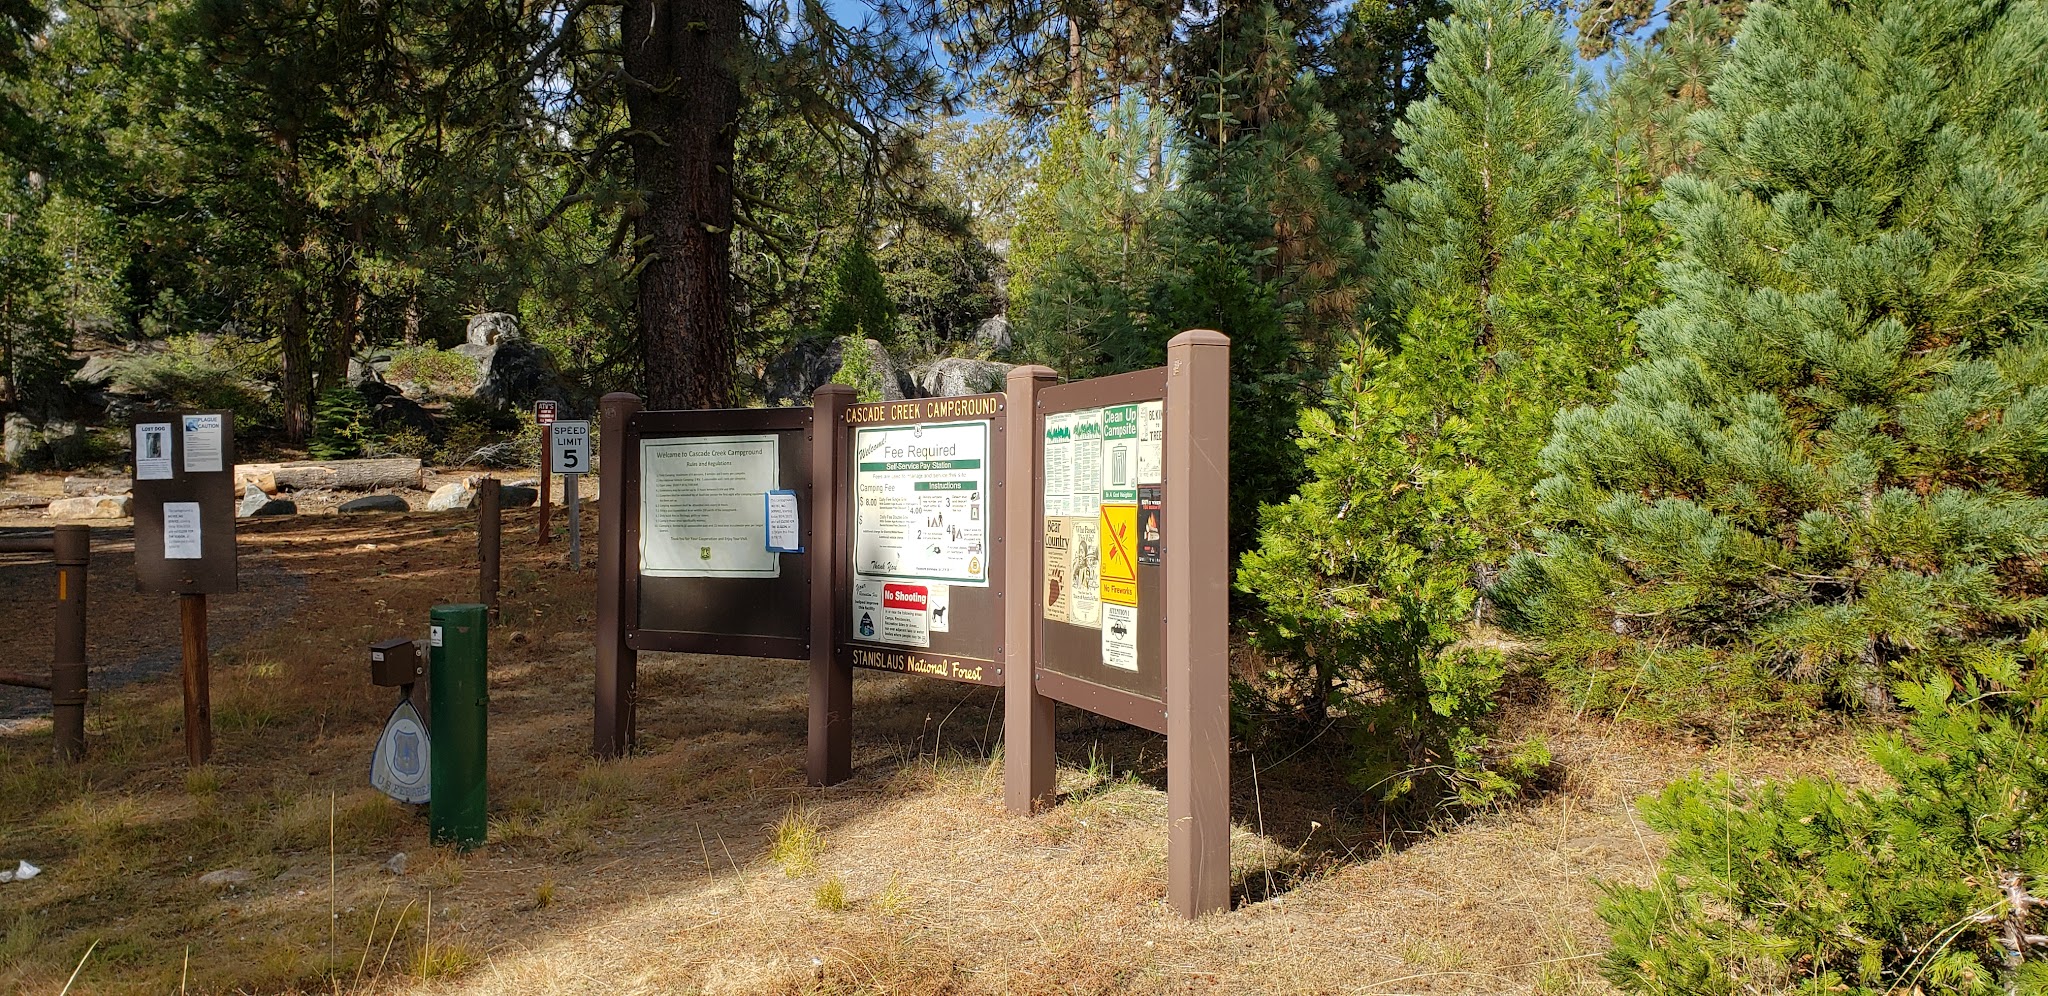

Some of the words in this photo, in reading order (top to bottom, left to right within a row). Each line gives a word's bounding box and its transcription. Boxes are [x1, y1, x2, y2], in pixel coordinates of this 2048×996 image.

[846, 406, 885, 423] CASCADE
[891, 404, 921, 420] CREEK
[927, 397, 997, 418] CAMPGROUND
[1104, 409, 1123, 424] Clean
[1125, 407, 1137, 424] Up
[554, 426, 586, 435] SPEED
[1103, 423, 1137, 438] Campsite
[557, 438, 582, 446] LIMIT
[858, 432, 888, 461] Welcome!
[711, 449, 727, 457] Creek
[727, 448, 763, 457] Campground
[884, 446, 903, 459] Fee
[908, 443, 956, 460] Required
[563, 449, 579, 469] 5
[885, 462, 919, 471] Self-Service
[919, 461, 930, 471] Pay
[932, 460, 952, 469] Station
[860, 484, 883, 493] Camping
[885, 483, 895, 491] Fee
[859, 496, 864, 507] $
[865, 498, 878, 506] 8.00
[945, 497, 951, 507] 3
[946, 525, 951, 534] 4
[1047, 520, 1061, 533] Bear
[917, 529, 922, 540] 2
[1045, 534, 1070, 549] Country
[870, 560, 886, 570] Thank
[886, 561, 897, 573] You
[1103, 584, 1110, 593] No
[1111, 585, 1132, 595] Fireworks
[884, 590, 894, 600] No
[895, 591, 927, 605] Shooting
[852, 649, 904, 670] STANISLAUS
[907, 655, 949, 677] National
[951, 661, 983, 681] Forest
[393, 784, 411, 797] FEE
